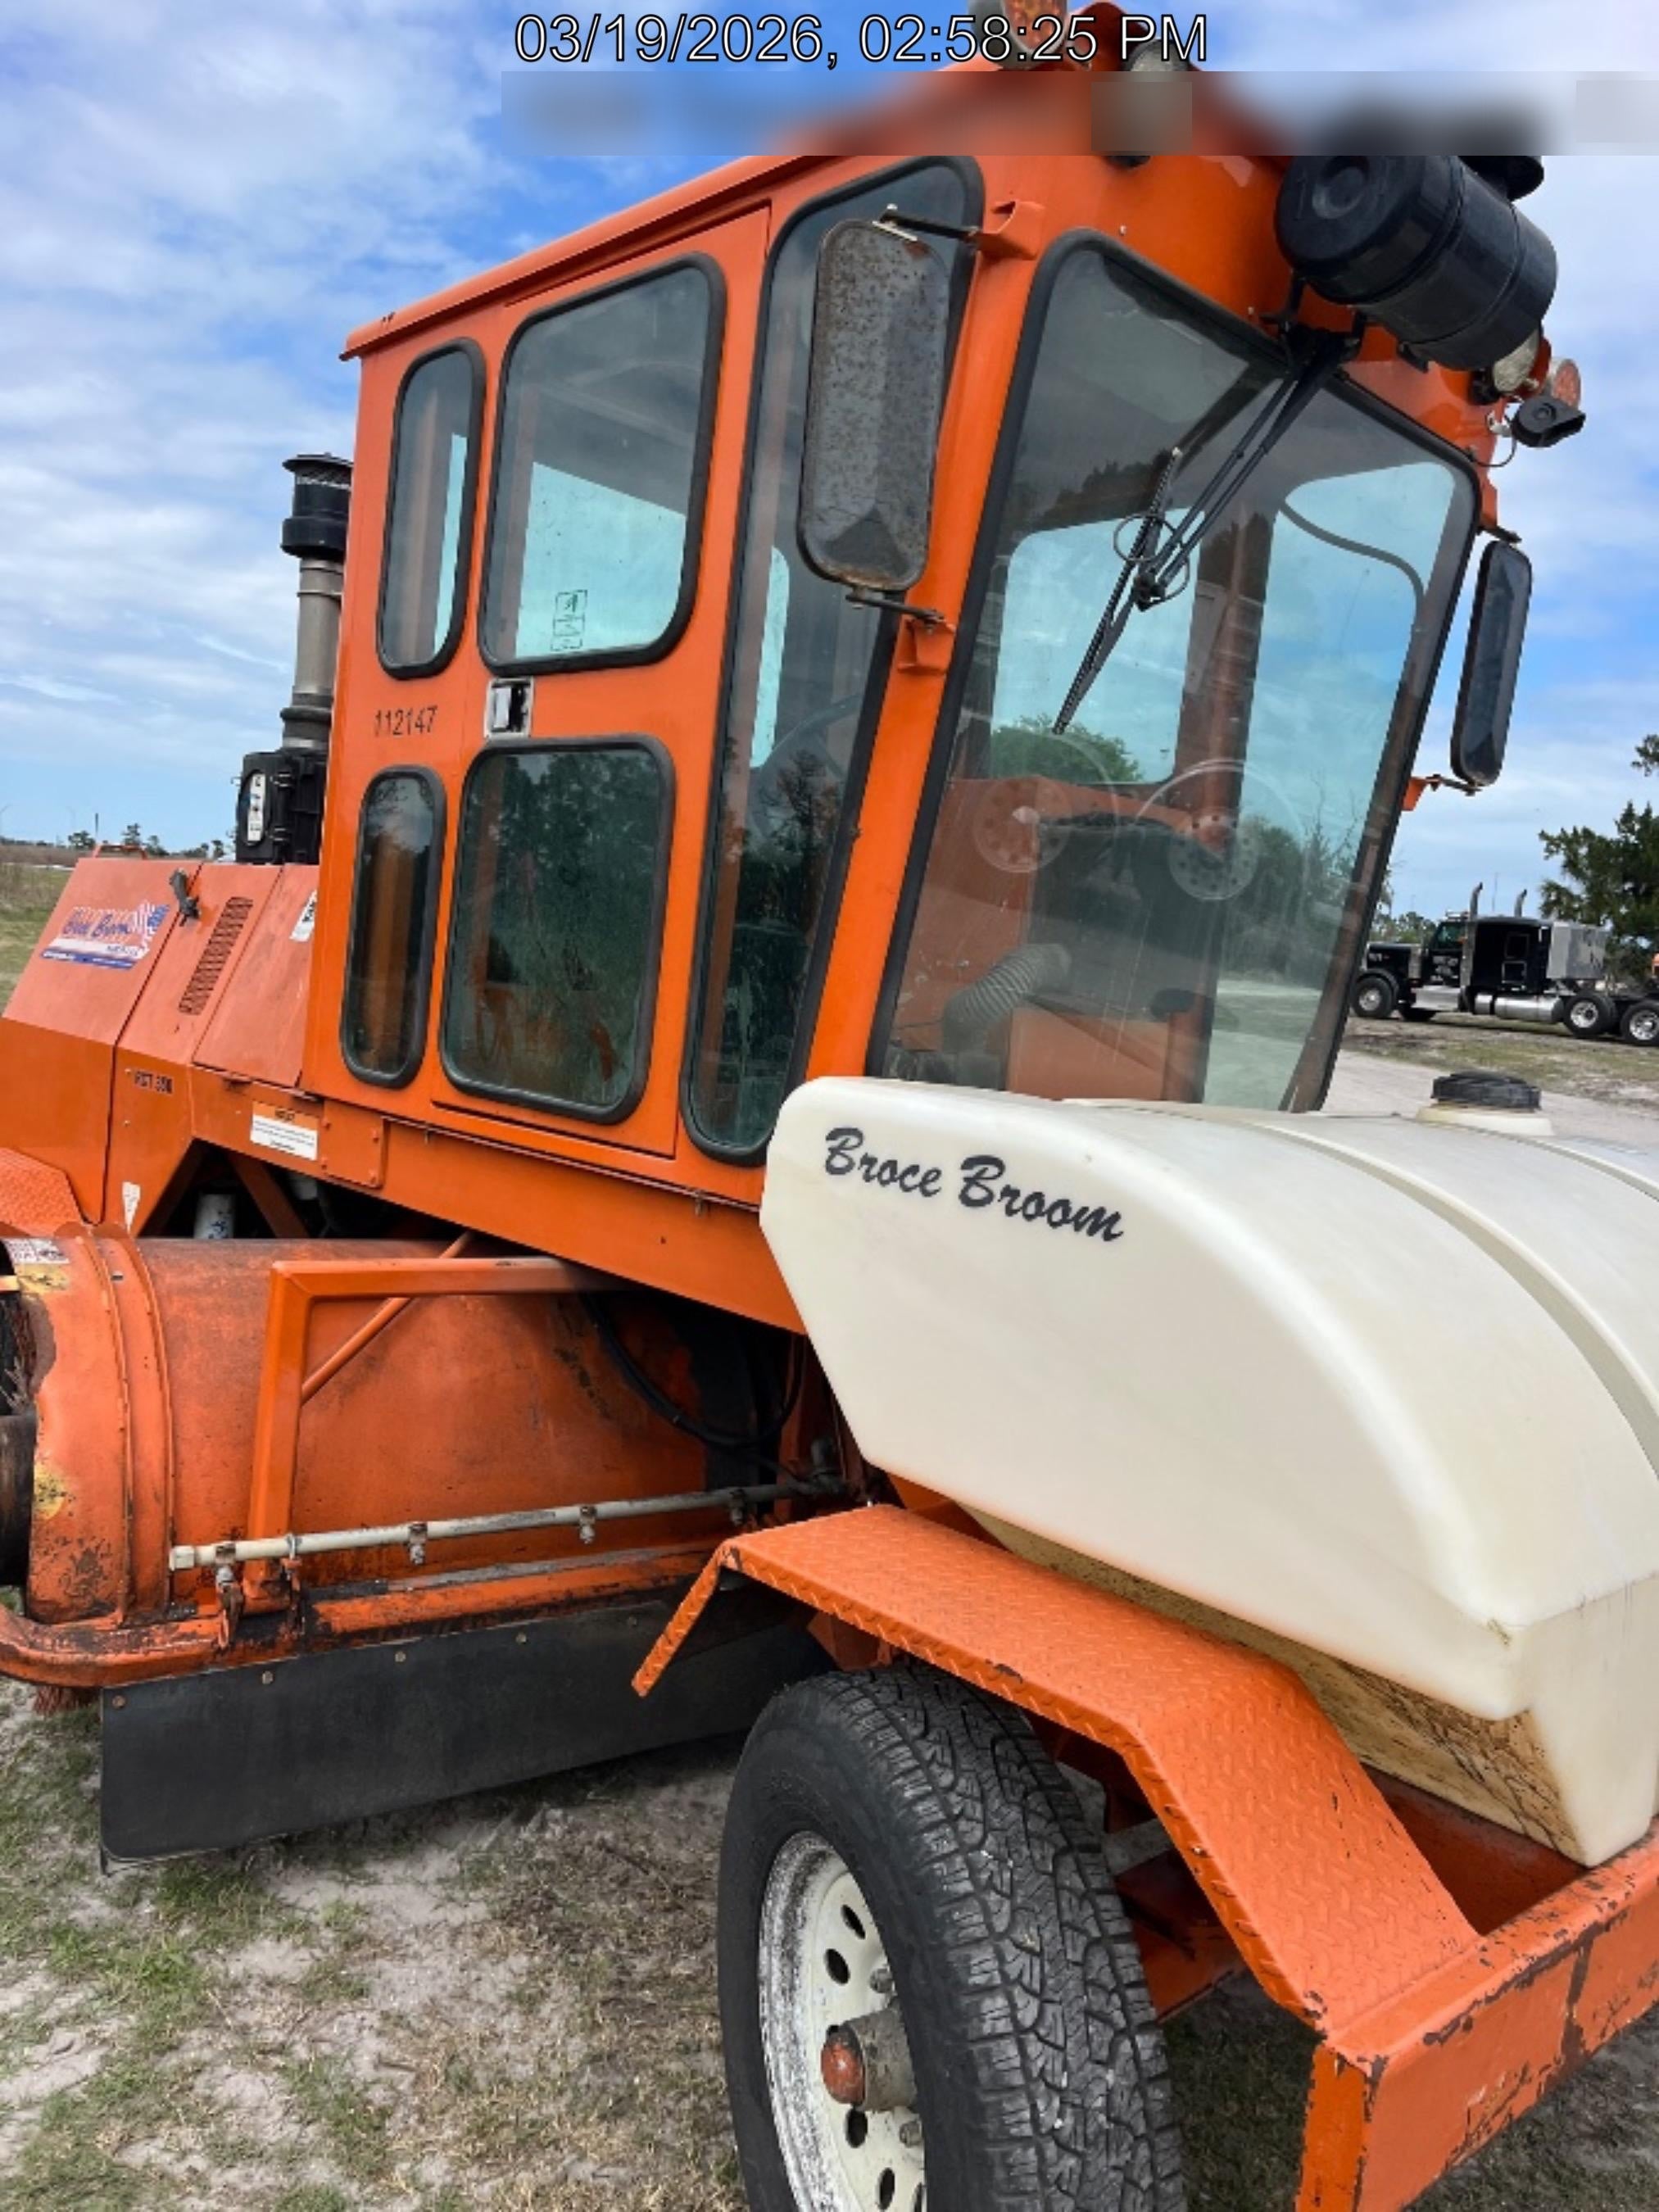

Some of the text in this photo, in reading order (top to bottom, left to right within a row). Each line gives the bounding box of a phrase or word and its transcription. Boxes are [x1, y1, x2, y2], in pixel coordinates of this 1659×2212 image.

[374, 705, 437, 737] 112147
[825, 1127, 1123, 1242] Broce Broom
